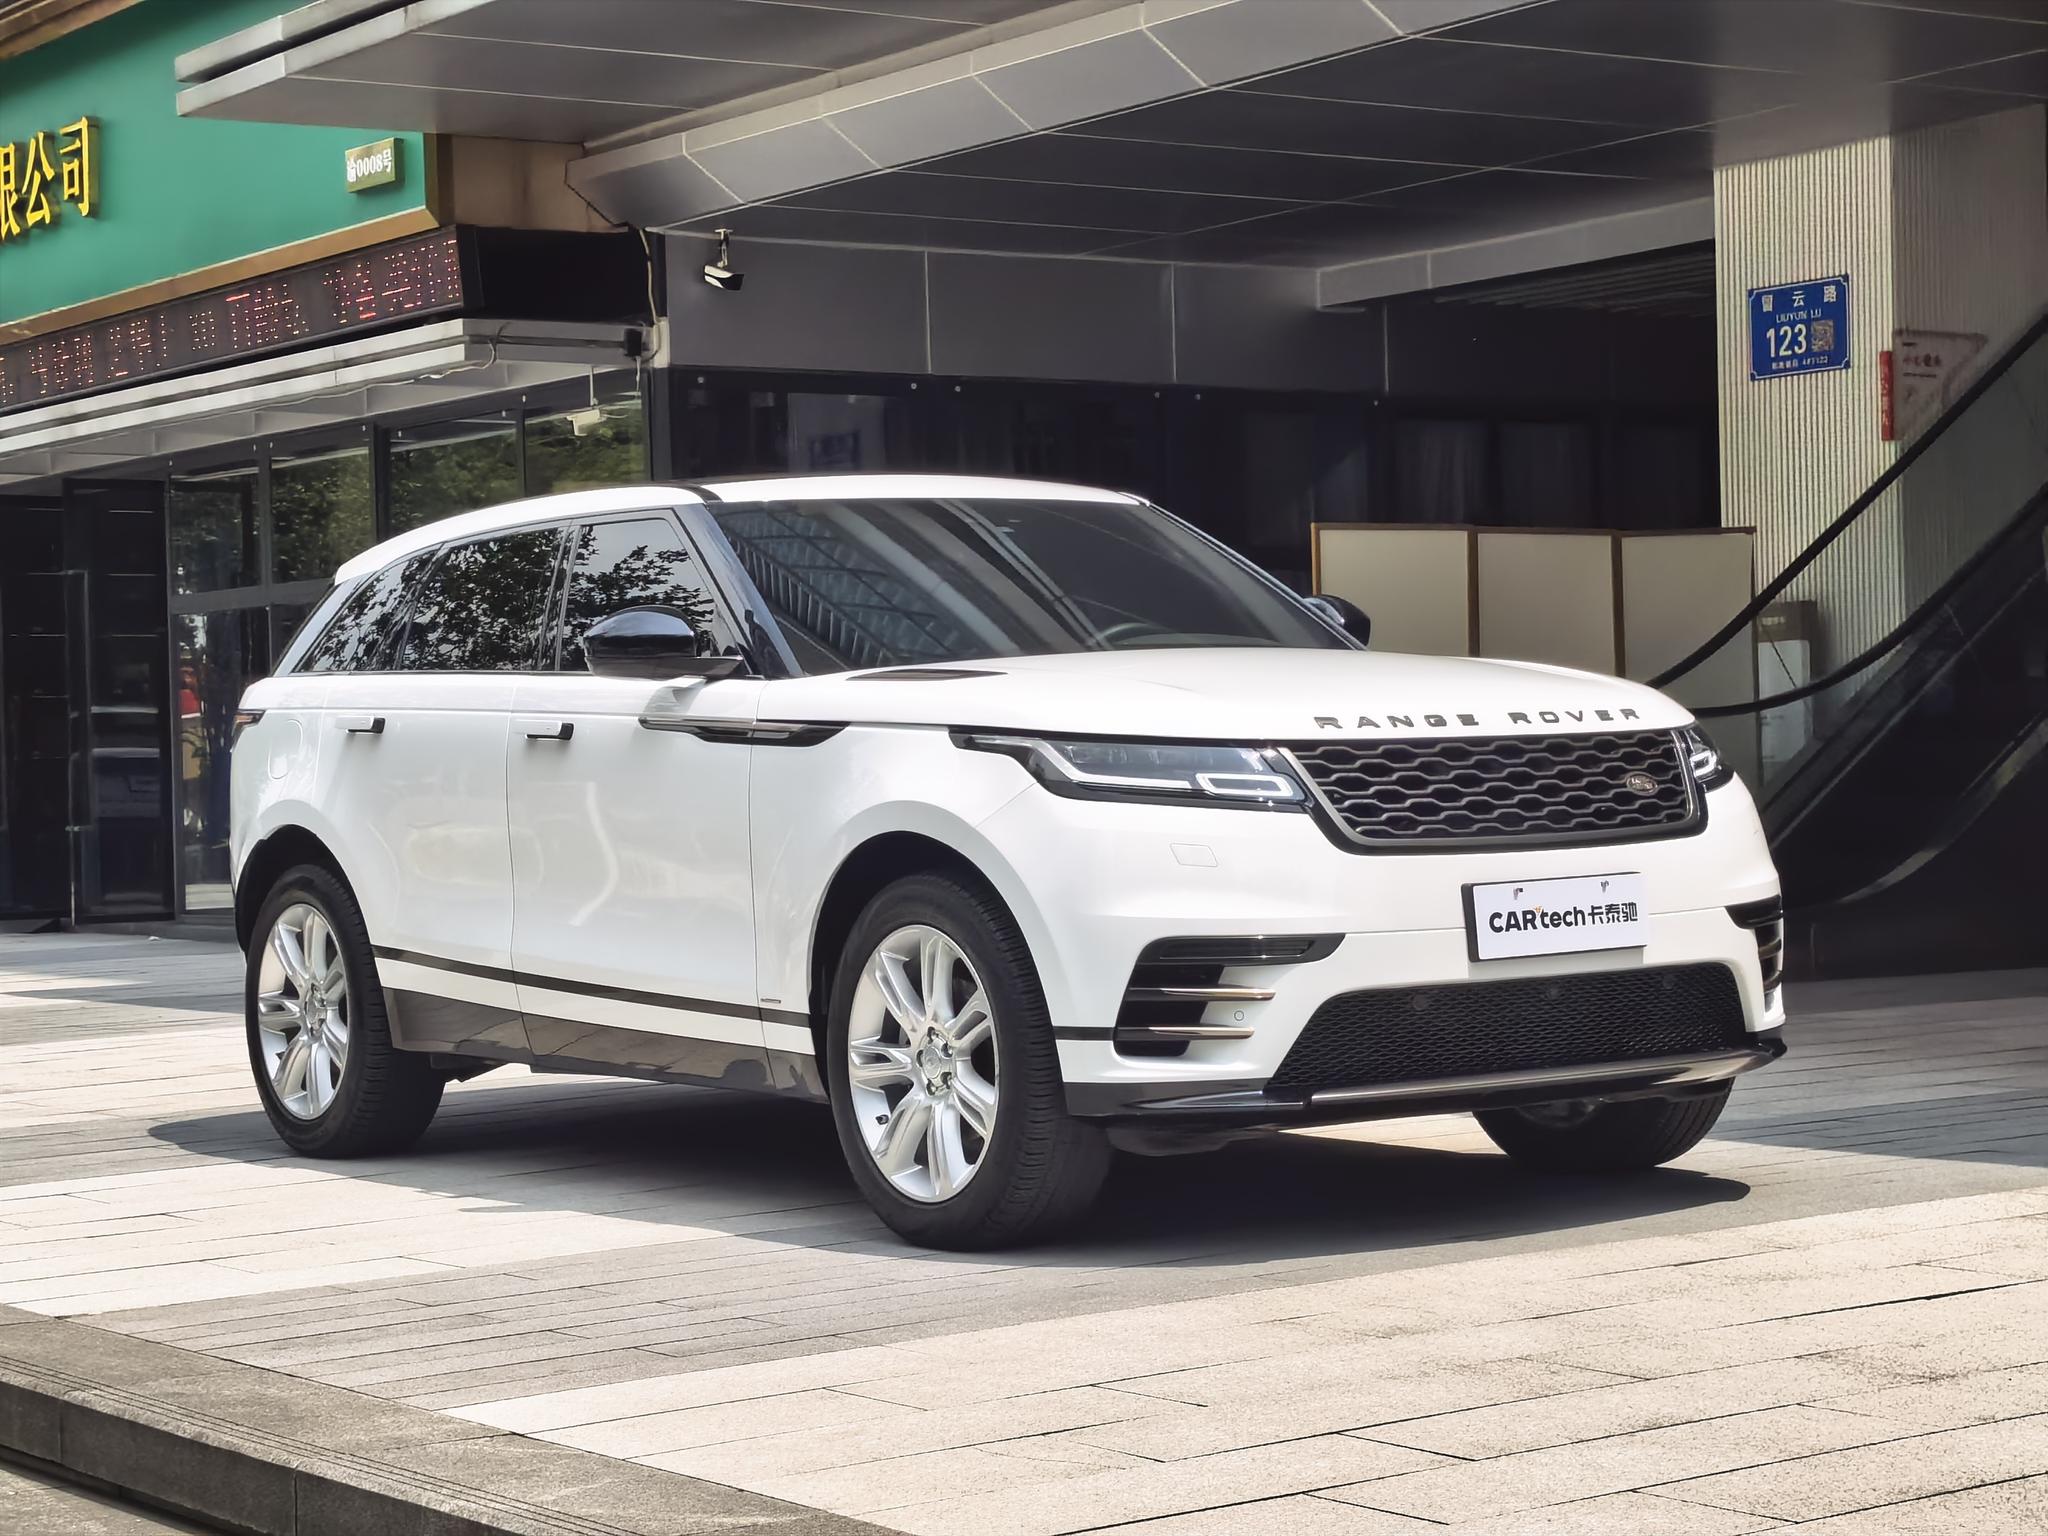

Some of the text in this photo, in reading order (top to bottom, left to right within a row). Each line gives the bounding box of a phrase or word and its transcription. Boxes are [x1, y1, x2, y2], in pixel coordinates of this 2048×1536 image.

[1766, 323, 1807, 358] 123
[1314, 708, 1640, 730] RANGE ROVER
